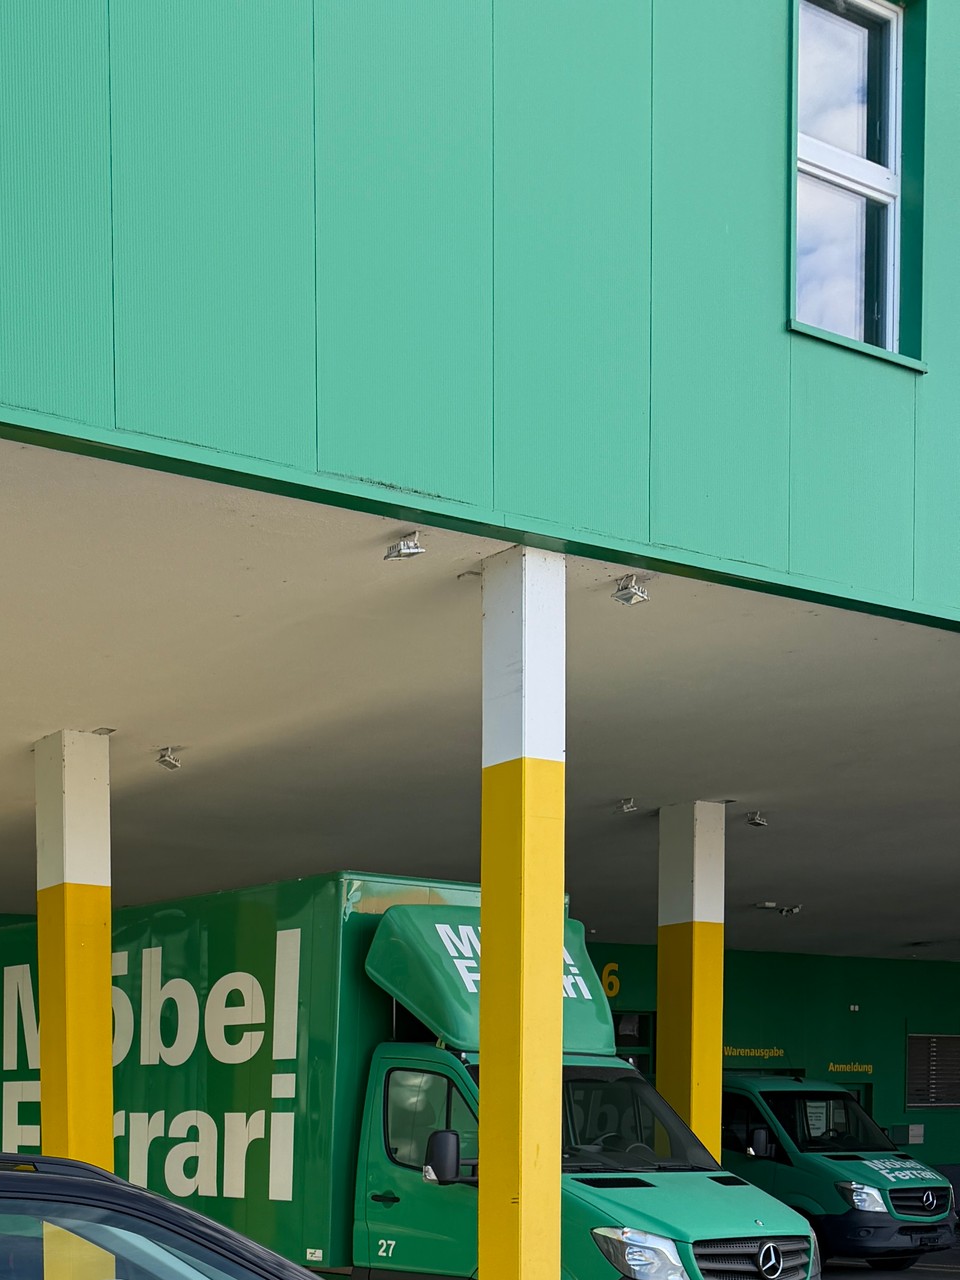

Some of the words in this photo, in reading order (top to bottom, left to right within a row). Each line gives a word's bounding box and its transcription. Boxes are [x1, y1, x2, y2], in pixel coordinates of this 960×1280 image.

[602, 962, 620, 997] 6
[724, 1046, 785, 1059] Warenausgabe
[828, 1062, 873, 1074] Anmeldung
[2, 1073, 296, 1201] Frari
[879, 1169, 943, 1182] Ferrari
[378, 1239, 396, 1257] 27
